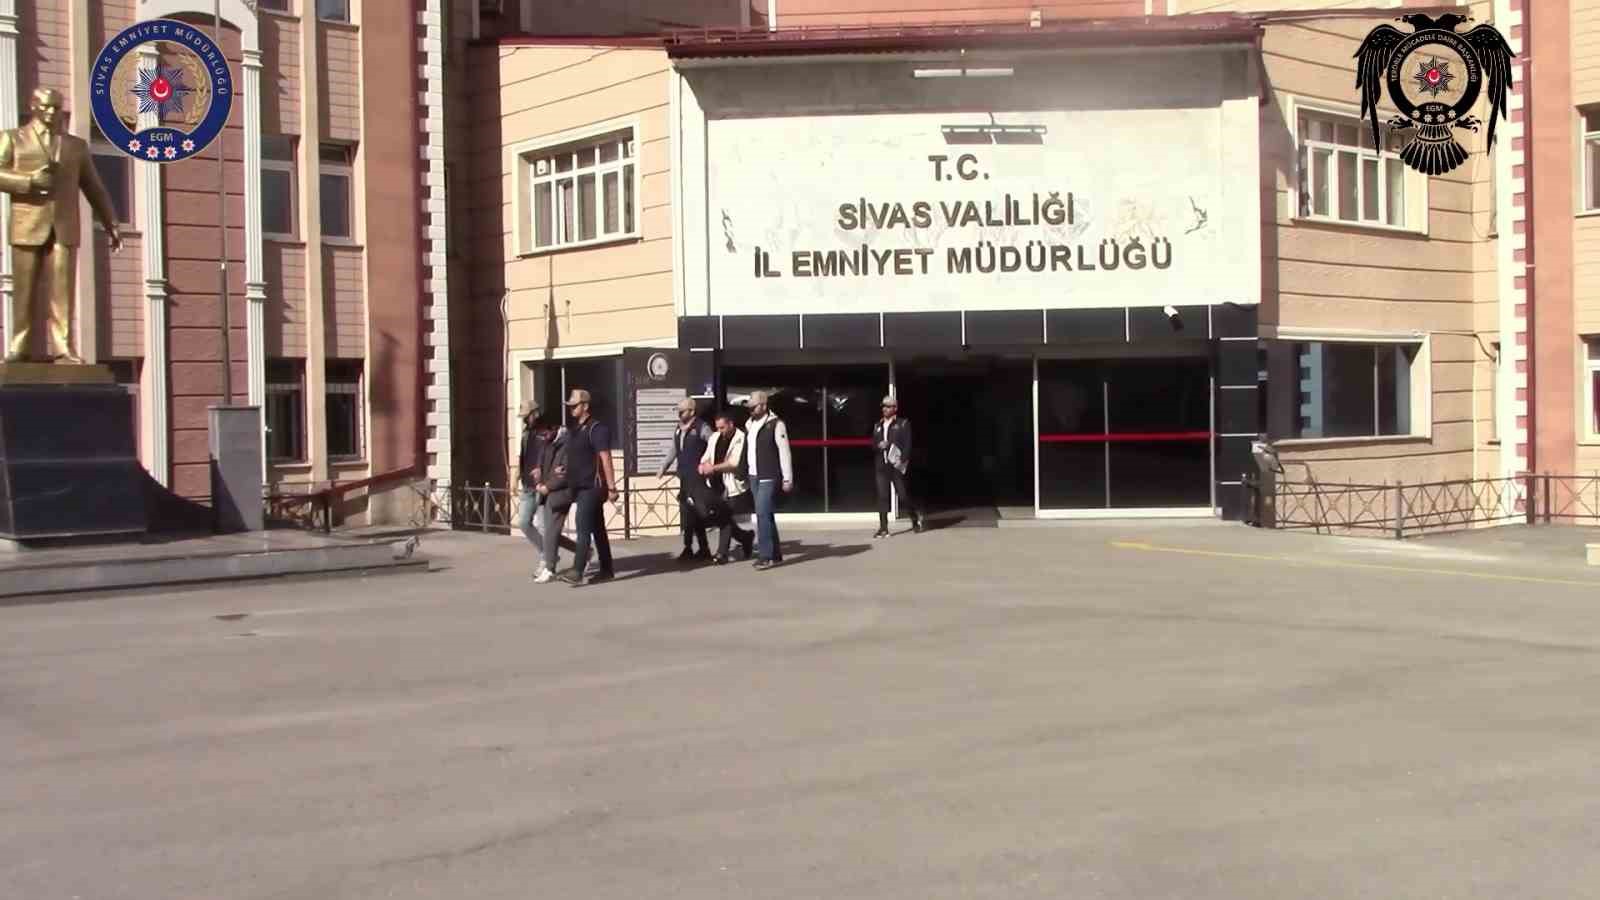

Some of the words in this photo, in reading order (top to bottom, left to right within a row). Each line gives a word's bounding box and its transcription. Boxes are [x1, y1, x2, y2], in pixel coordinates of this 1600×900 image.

[928, 153, 990, 181] T.C.
[837, 197, 932, 230] SİVAS
[939, 191, 1075, 228] VALİLİĞİ
[753, 246, 782, 278] İL
[791, 243, 934, 277] EMNİYET
[946, 236, 1172, 273] MÜDÜRLÜĞÜ
